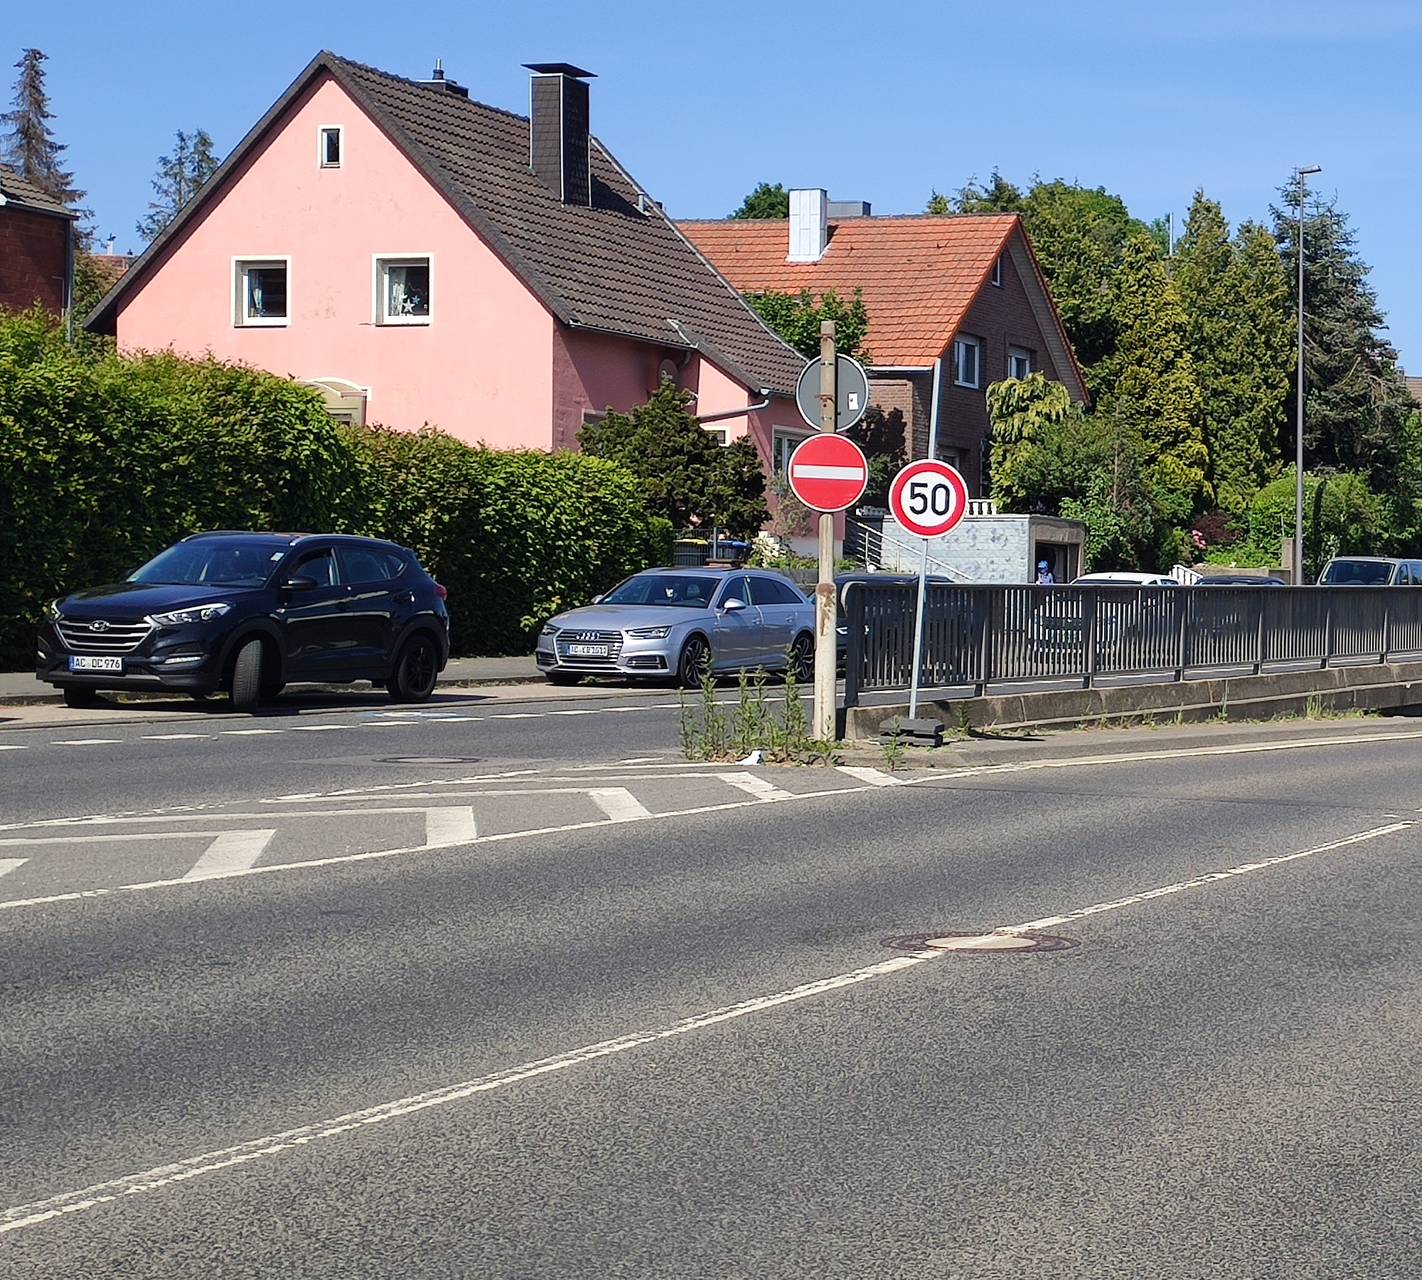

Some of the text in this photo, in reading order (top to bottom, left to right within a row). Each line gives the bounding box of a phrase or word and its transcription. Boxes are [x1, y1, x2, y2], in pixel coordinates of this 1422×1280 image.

[909, 482, 950, 516] 50
[75, 658, 86, 667] AC
[104, 659, 120, 669] 976
